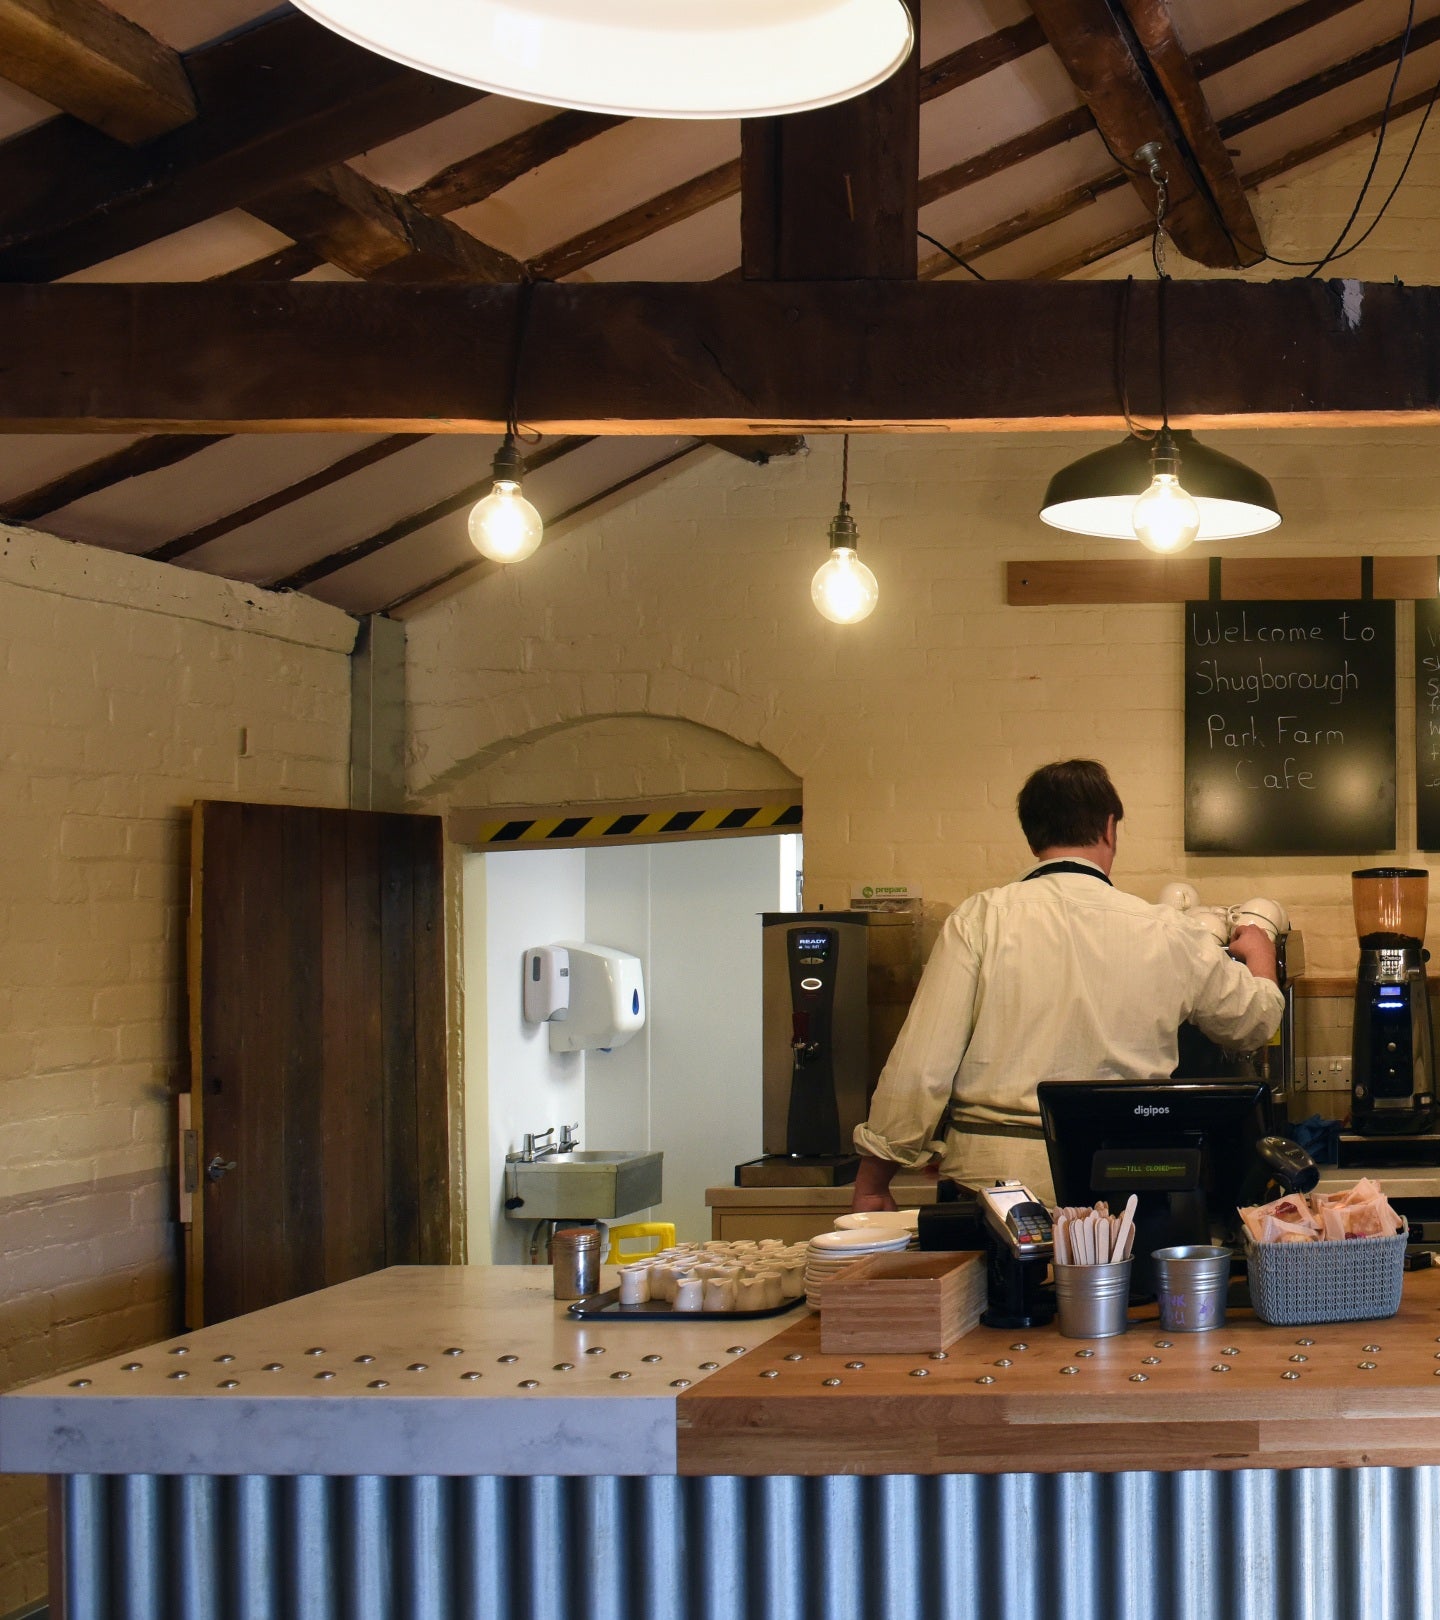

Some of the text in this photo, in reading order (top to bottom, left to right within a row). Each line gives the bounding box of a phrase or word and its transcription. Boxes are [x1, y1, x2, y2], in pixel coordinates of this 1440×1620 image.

[1193, 611, 1375, 646] Welcome to
[1196, 657, 1358, 704] Shugborough
[1207, 714, 1344, 749] Park Farm
[1134, 1105, 1170, 1117] digipos
